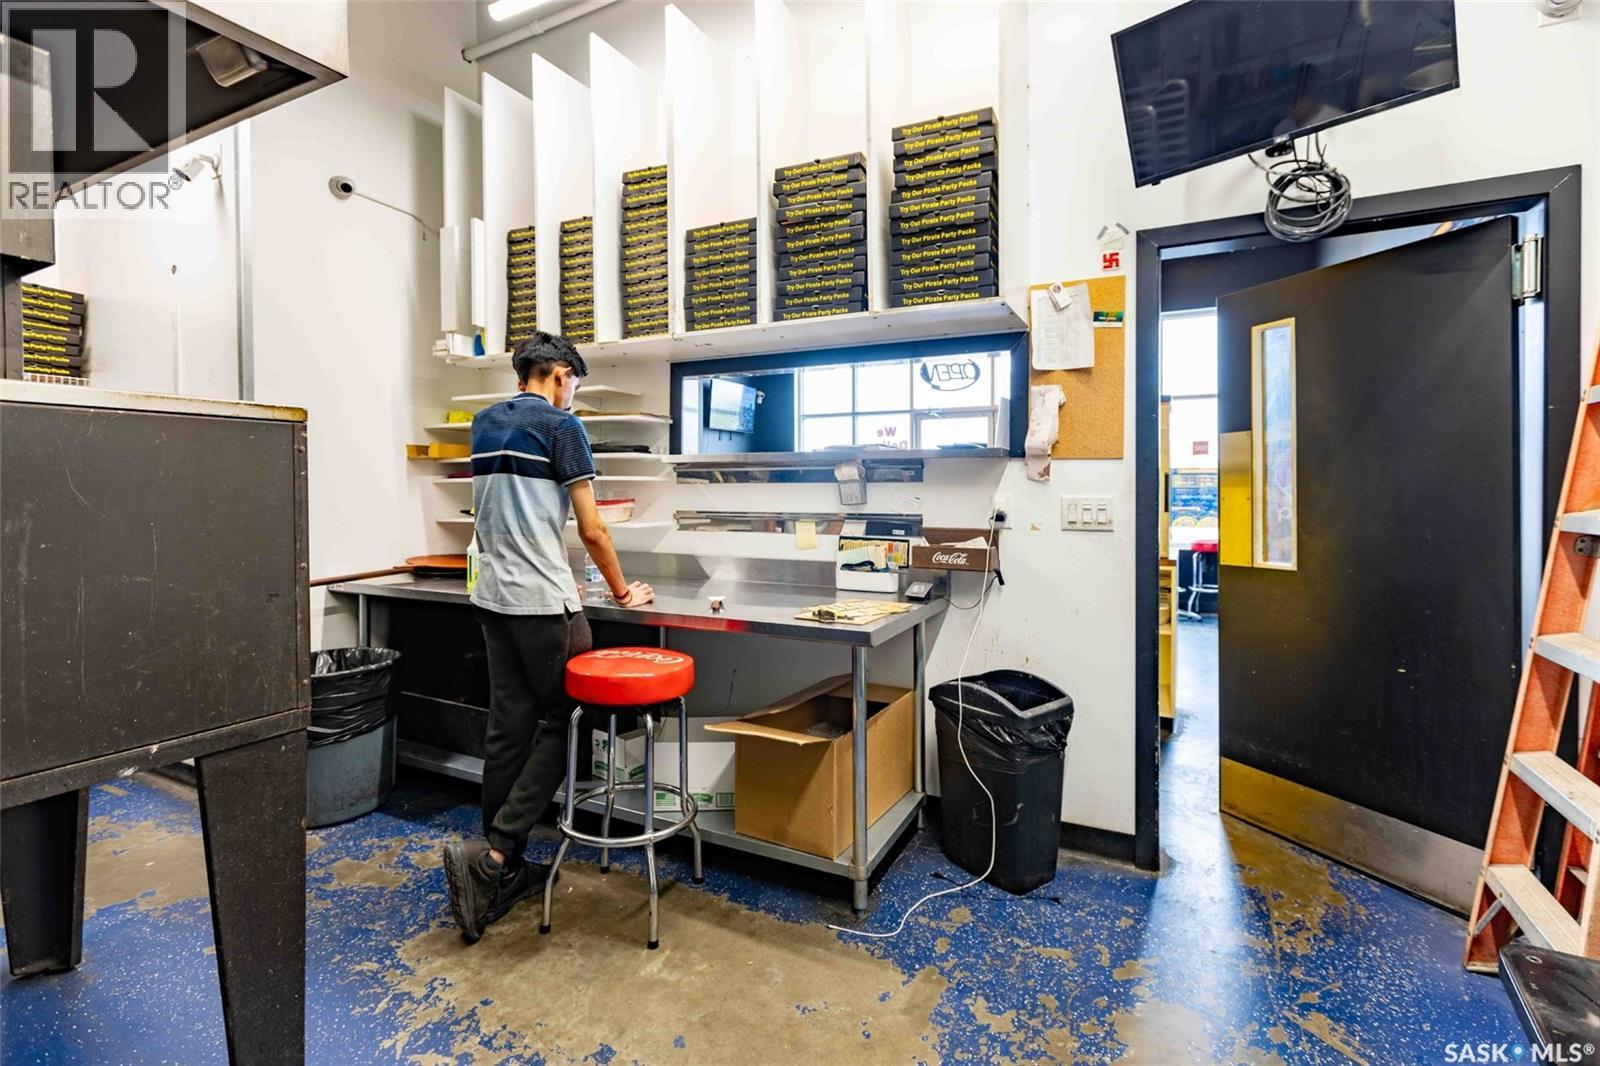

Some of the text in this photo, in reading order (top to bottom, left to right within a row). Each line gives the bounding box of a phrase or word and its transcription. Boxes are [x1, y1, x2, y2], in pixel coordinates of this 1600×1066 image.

[903, 113, 978, 137] Try Our Pirate Party Packs
[905, 129, 981, 151] Try Our Pirate Party Packs
[904, 145, 979, 167] Try Our Pirate Party Packs
[802, 163, 817, 173] Pirate
[818, 160, 832, 172] Party
[833, 157, 849, 169] Packs
[905, 162, 981, 182] Try Our Pirate Party Packs
[801, 178, 816, 187] Pirate
[817, 175, 830, 185] Party
[832, 174, 847, 182] Packs
[806, 192, 821, 202] Pirate
[822, 189, 836, 198] Party
[837, 187, 853, 196] Packs
[902, 179, 977, 199] Try Our Pirate Party Packs
[805, 206, 820, 215] Pirate
[821, 205, 835, 213] Party
[836, 202, 852, 210] Packs
[900, 195, 975, 213] Try Our Pirate Party Packs
[820, 220, 834, 229] Party
[835, 218, 850, 227] Packs
[901, 210, 974, 230] Try Our Pirate Party Packs
[805, 237, 819, 245] Pirate
[821, 234, 834, 243] Party
[835, 232, 851, 240] Packs
[902, 228, 976, 246] Try Our Pirate Party Packs
[809, 251, 823, 259] Pirate
[839, 247, 854, 255] Packs
[902, 244, 975, 261] Try Our Pirate Party Packs
[807, 266, 822, 274] Pirate
[823, 263, 837, 271] Party
[838, 262, 853, 270] Packs
[901, 260, 974, 276] Try Our Pirate Party Packs
[903, 276, 978, 291] Try Our Pirate Party Packs
[903, 292, 979, 306] Try Our Pirate Party Packs
